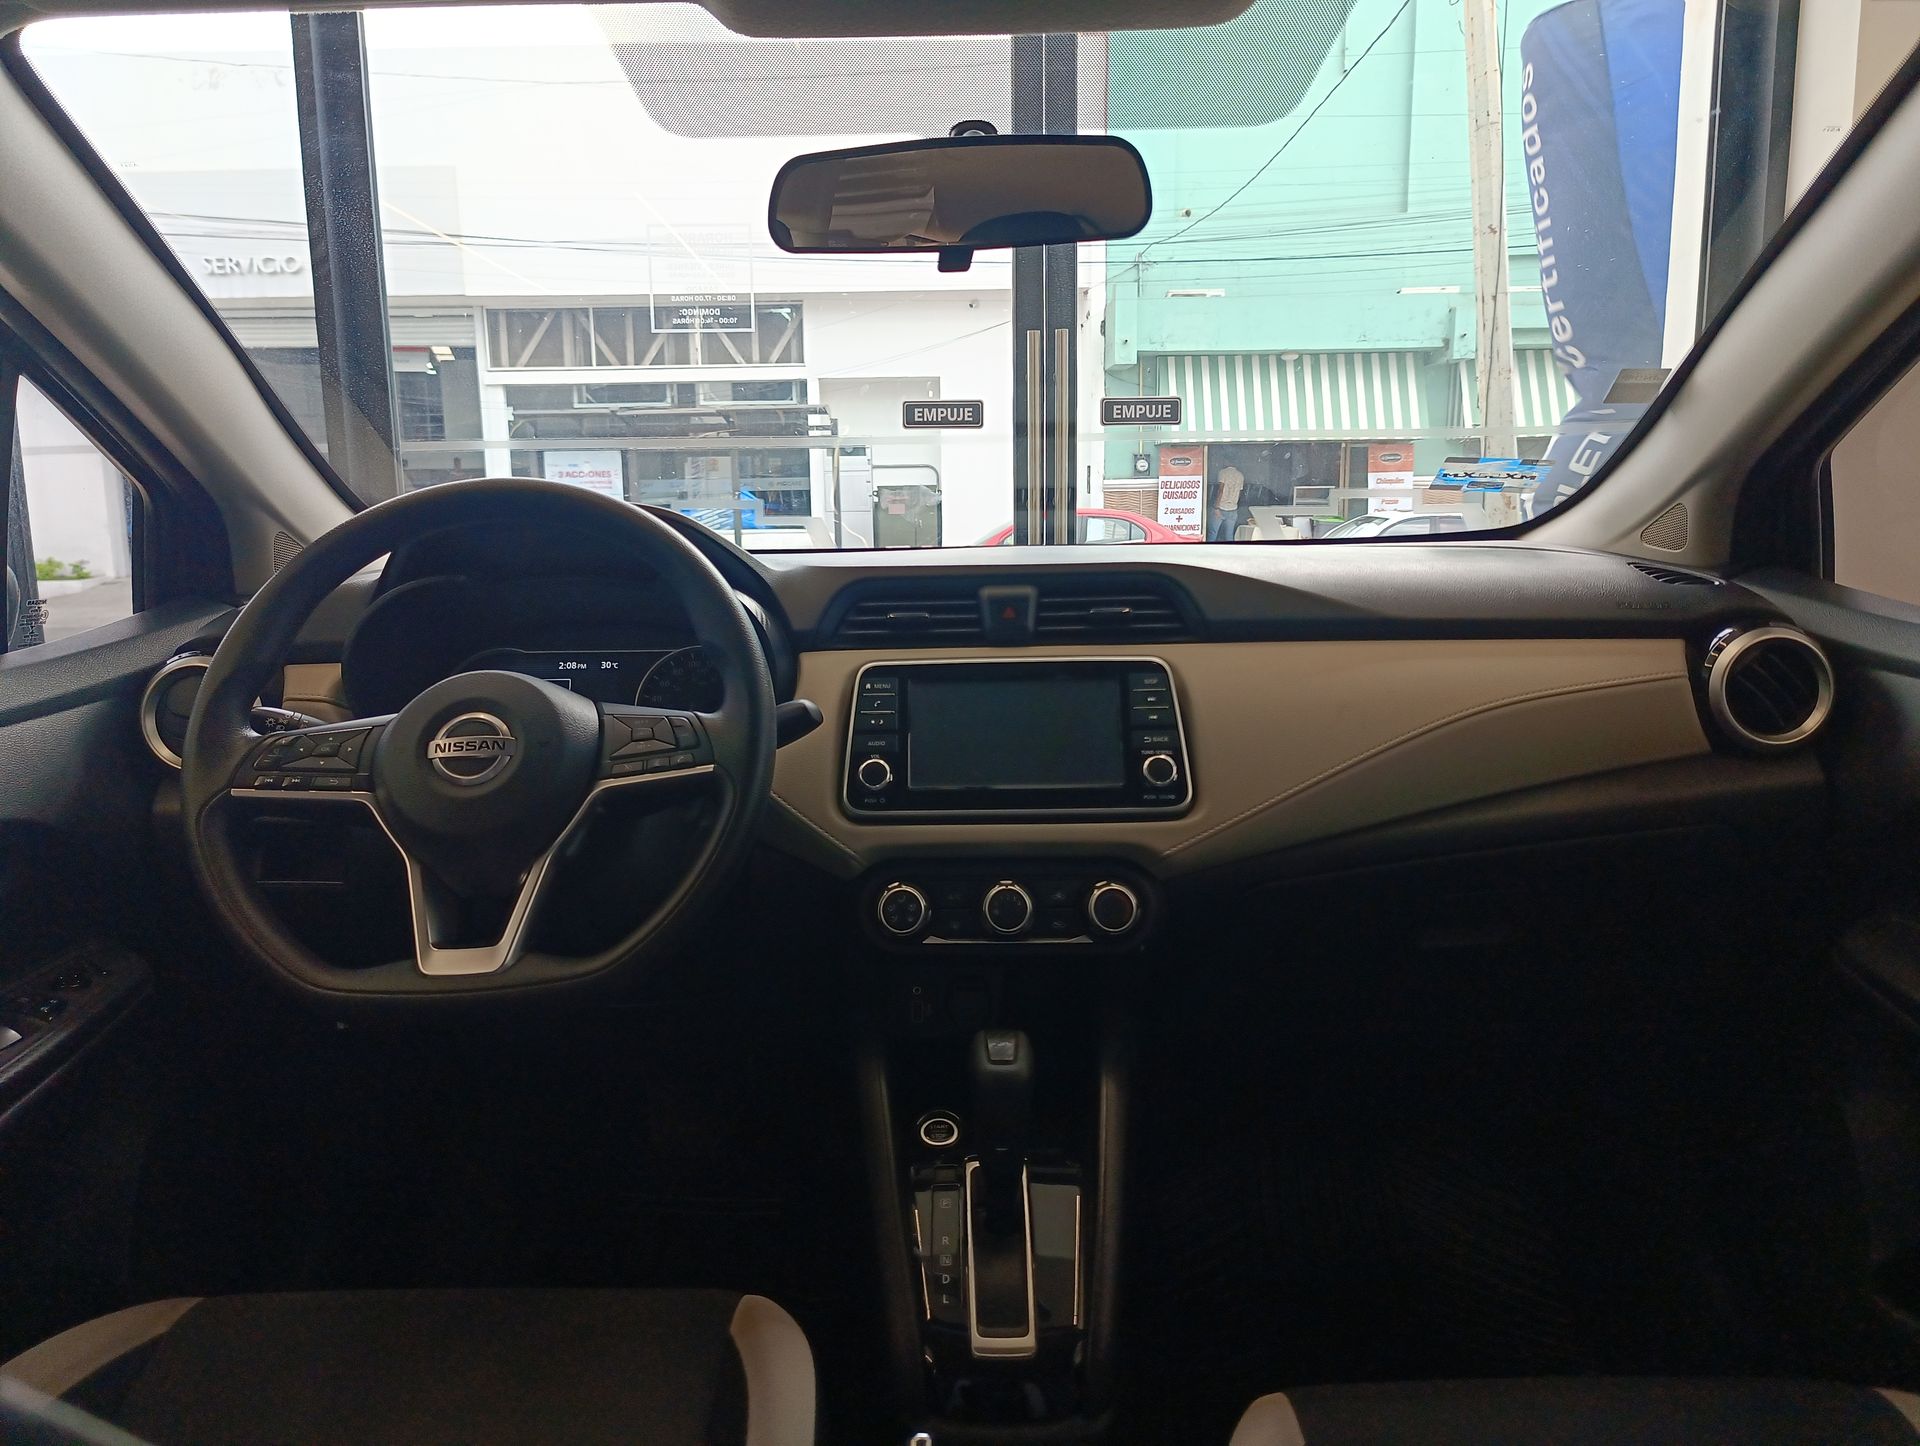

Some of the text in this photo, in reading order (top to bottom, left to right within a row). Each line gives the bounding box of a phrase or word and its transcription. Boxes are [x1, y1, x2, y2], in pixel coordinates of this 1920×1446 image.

[203, 256, 304, 275] SERVICIO
[914, 408, 973, 421] EMPUJE
[1112, 404, 1171, 418] EMPUJE
[1160, 480, 1200, 489] DELICIOSOS
[1162, 490, 1198, 499] GUISADOS
[434, 740, 506, 754] NISSAN
[942, 1236, 949, 1245] R
[942, 1274, 950, 1284] D
[942, 1294, 949, 1304] L
